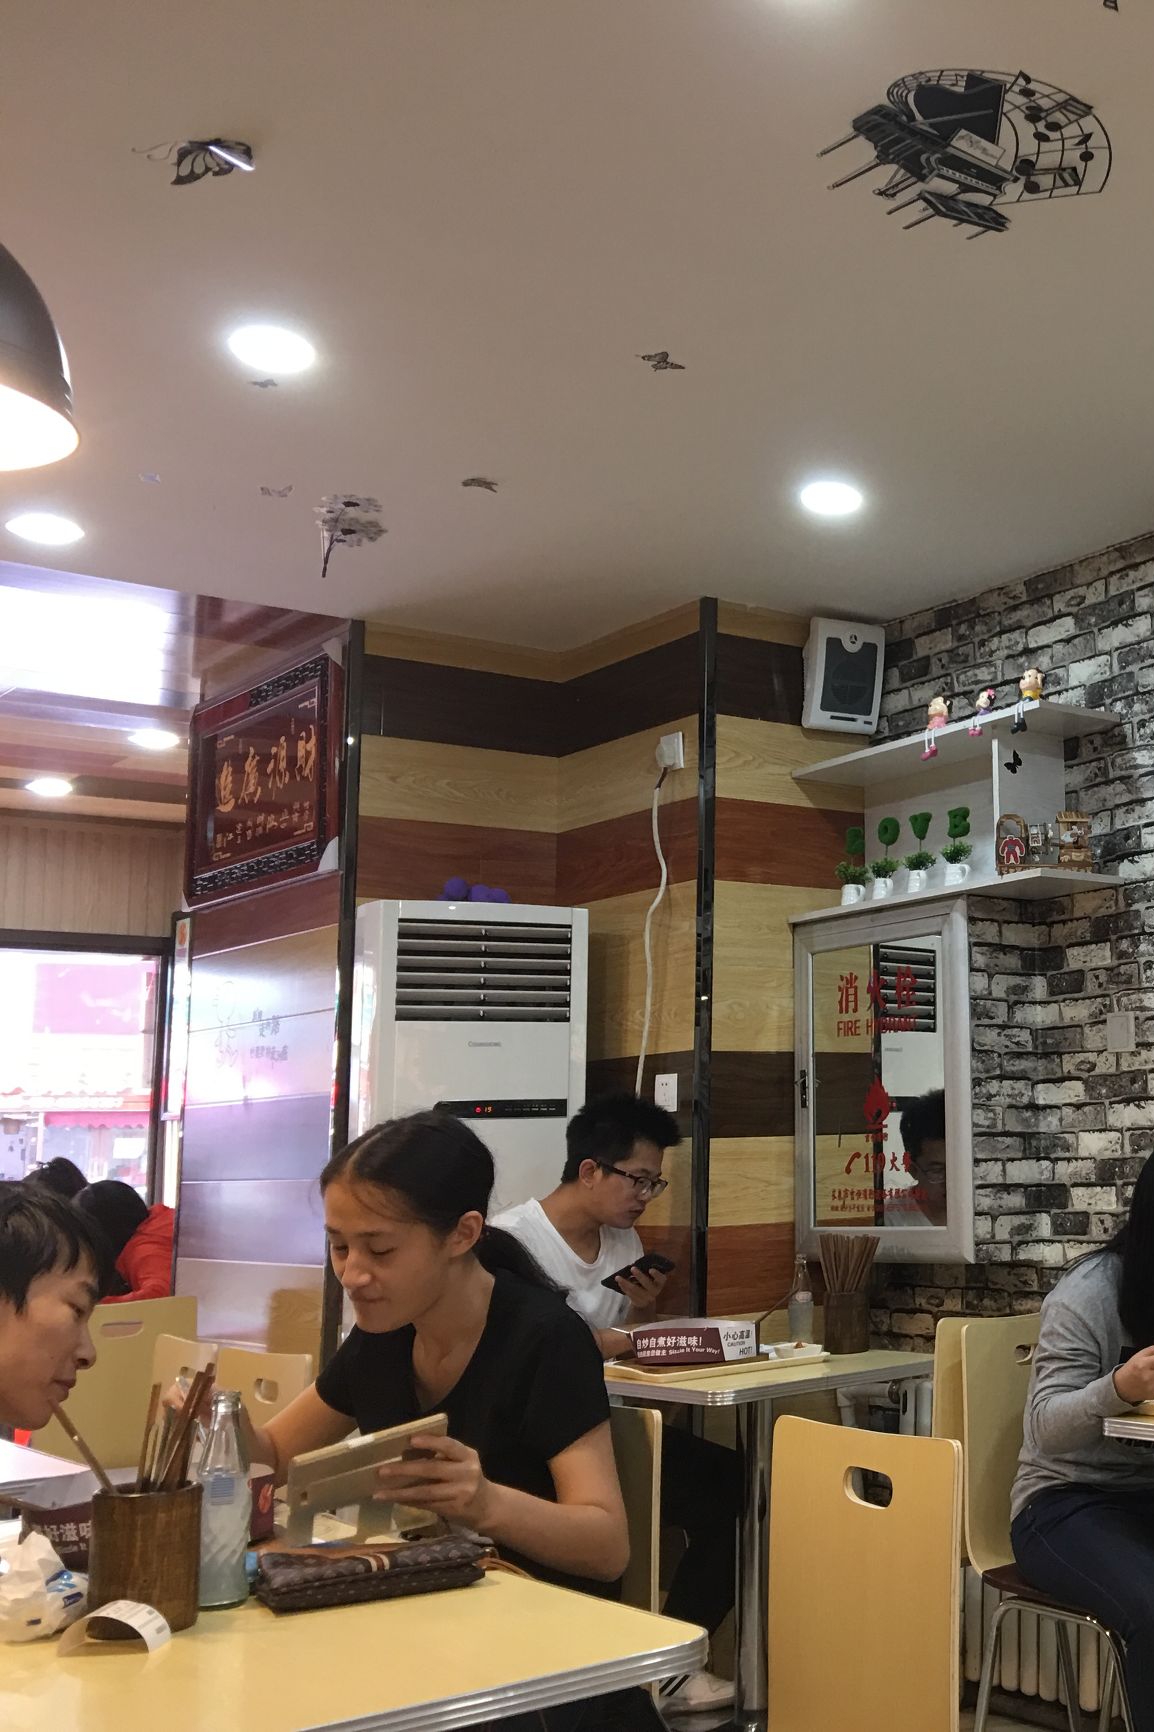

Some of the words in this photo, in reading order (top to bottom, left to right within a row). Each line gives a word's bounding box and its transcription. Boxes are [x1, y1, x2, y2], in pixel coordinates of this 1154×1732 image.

[837, 966, 917, 1014] 消火栓
[836, 1019, 861, 1037] FIRE
[636, 1335, 702, 1350] 自炒自煮好滋味!
